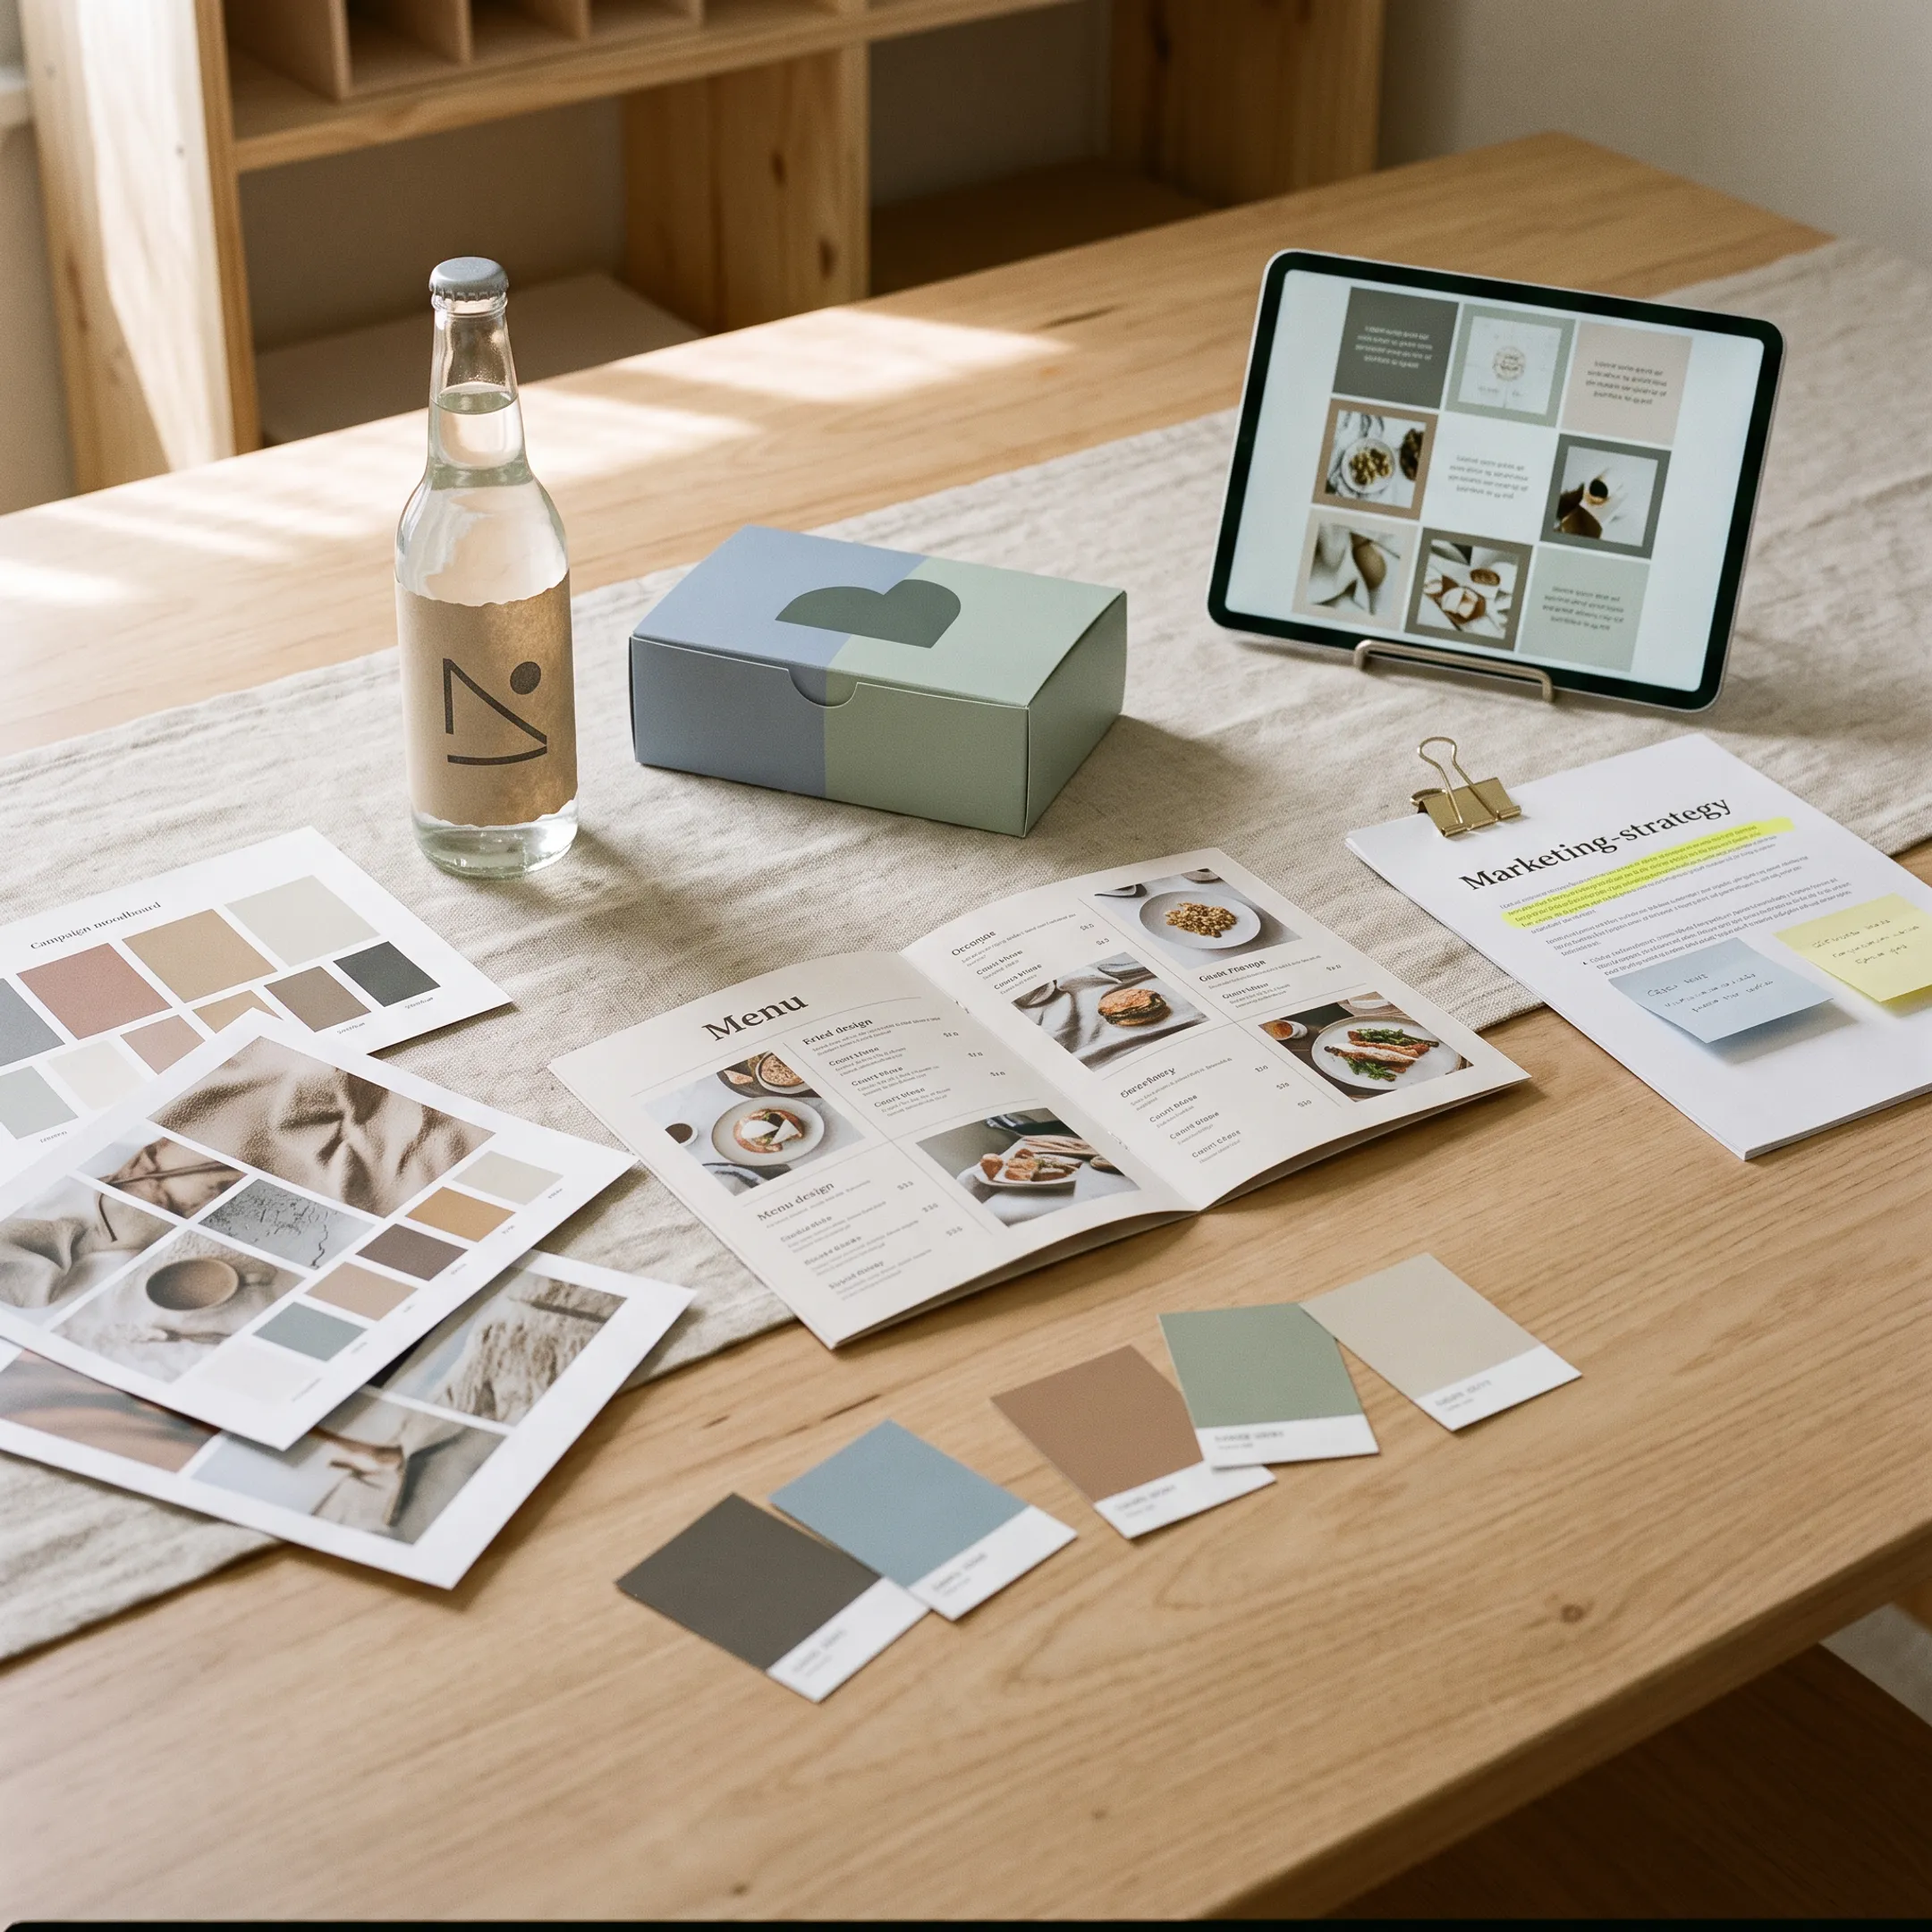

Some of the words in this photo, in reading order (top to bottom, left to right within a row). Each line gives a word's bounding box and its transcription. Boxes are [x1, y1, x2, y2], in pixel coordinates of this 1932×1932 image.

[1458, 799, 1731, 891] Marketing-strategy
[30, 926, 91, 950] Campaign
[701, 995, 809, 1042] Menu
[835, 1018, 873, 1035] design
[757, 1201, 794, 1221] Menu
[794, 1182, 835, 1205] design
